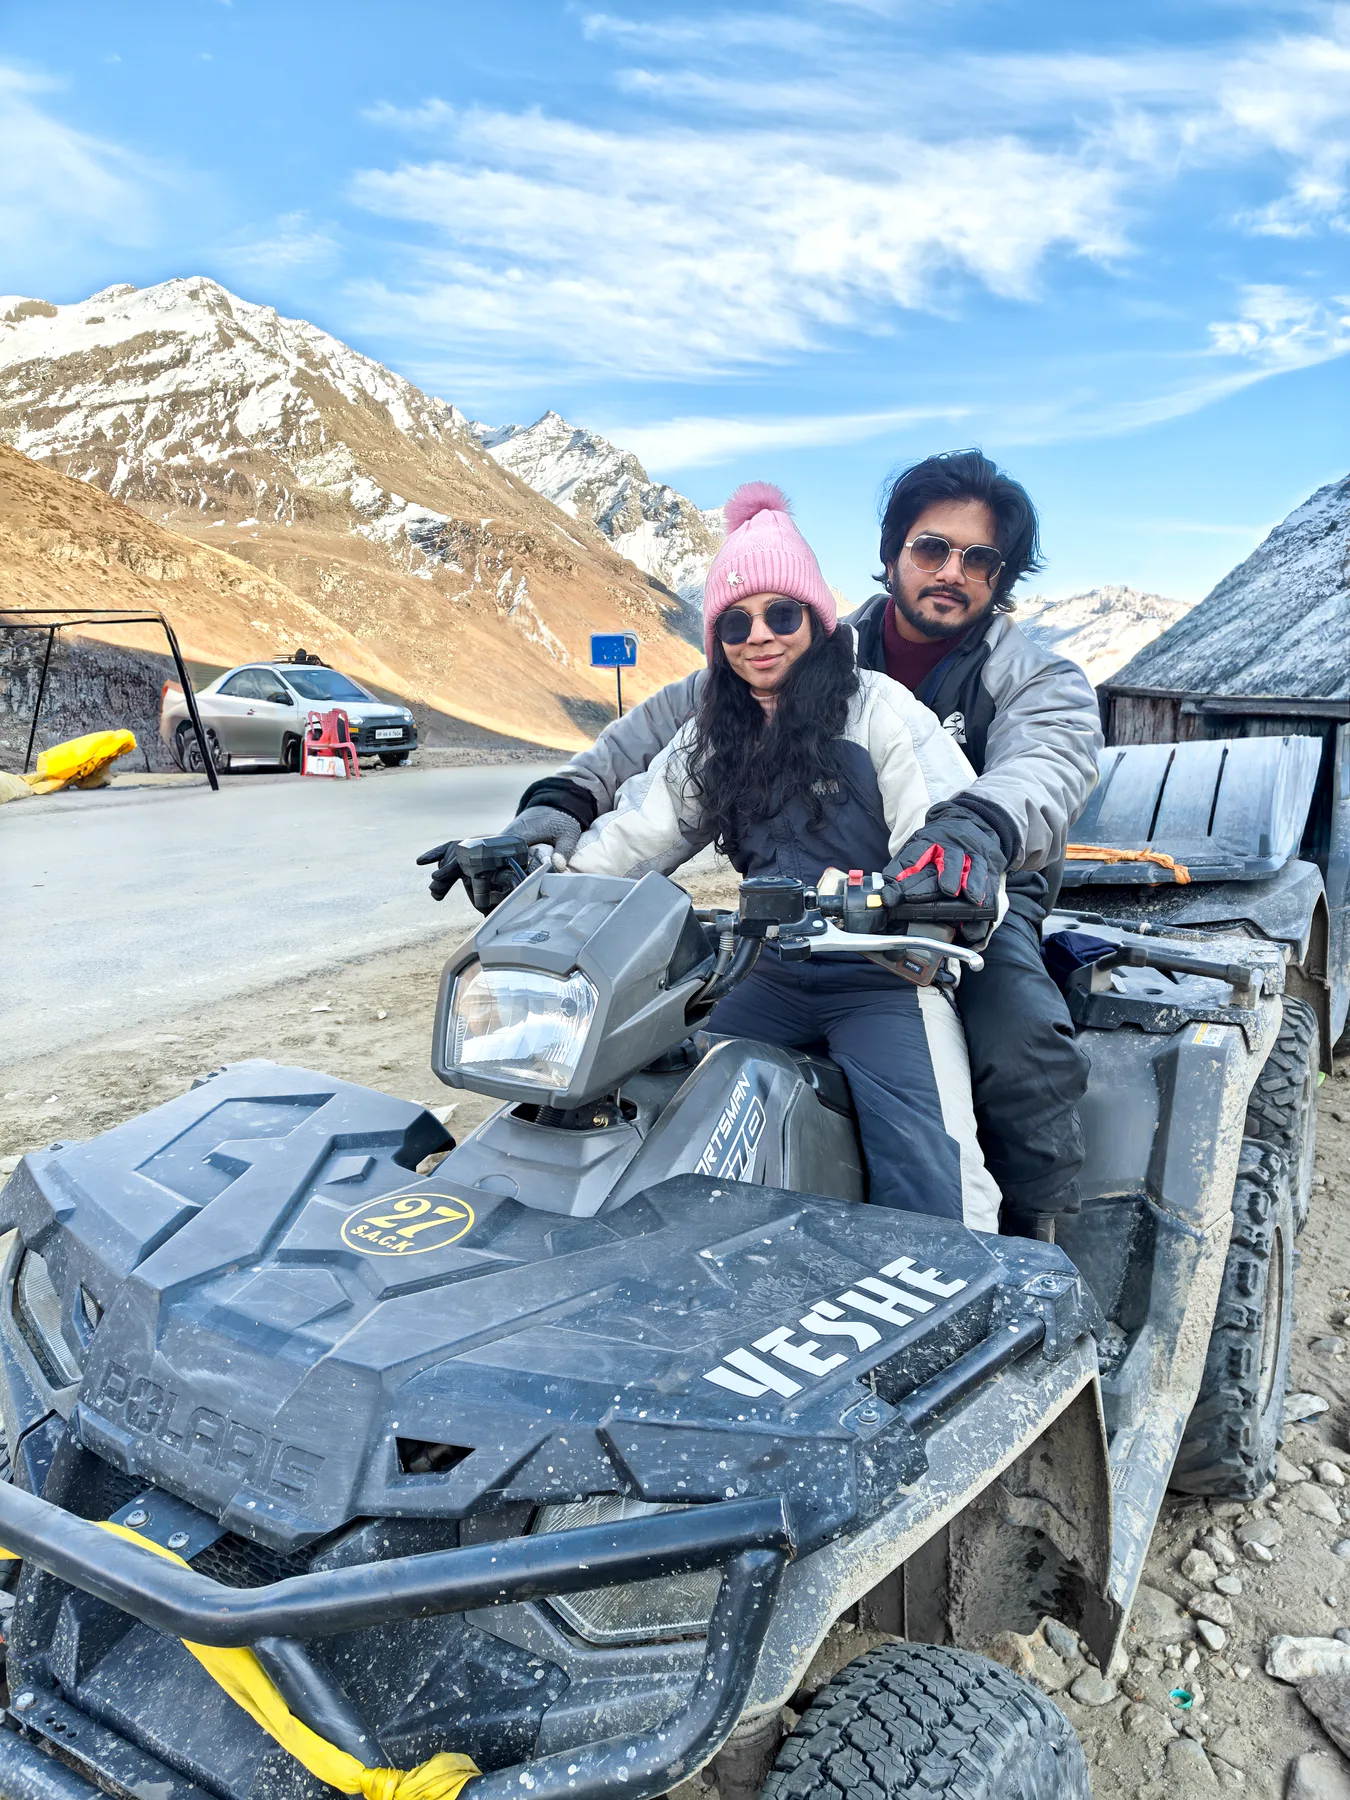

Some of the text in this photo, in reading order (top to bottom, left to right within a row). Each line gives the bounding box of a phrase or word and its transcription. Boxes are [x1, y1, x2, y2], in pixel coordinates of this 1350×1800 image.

[350, 1224, 415, 1252] S.A.C.K
[363, 1197, 468, 1238] 27
[701, 1255, 969, 1399] VESHE
[98, 1359, 326, 1511] POLARIS
